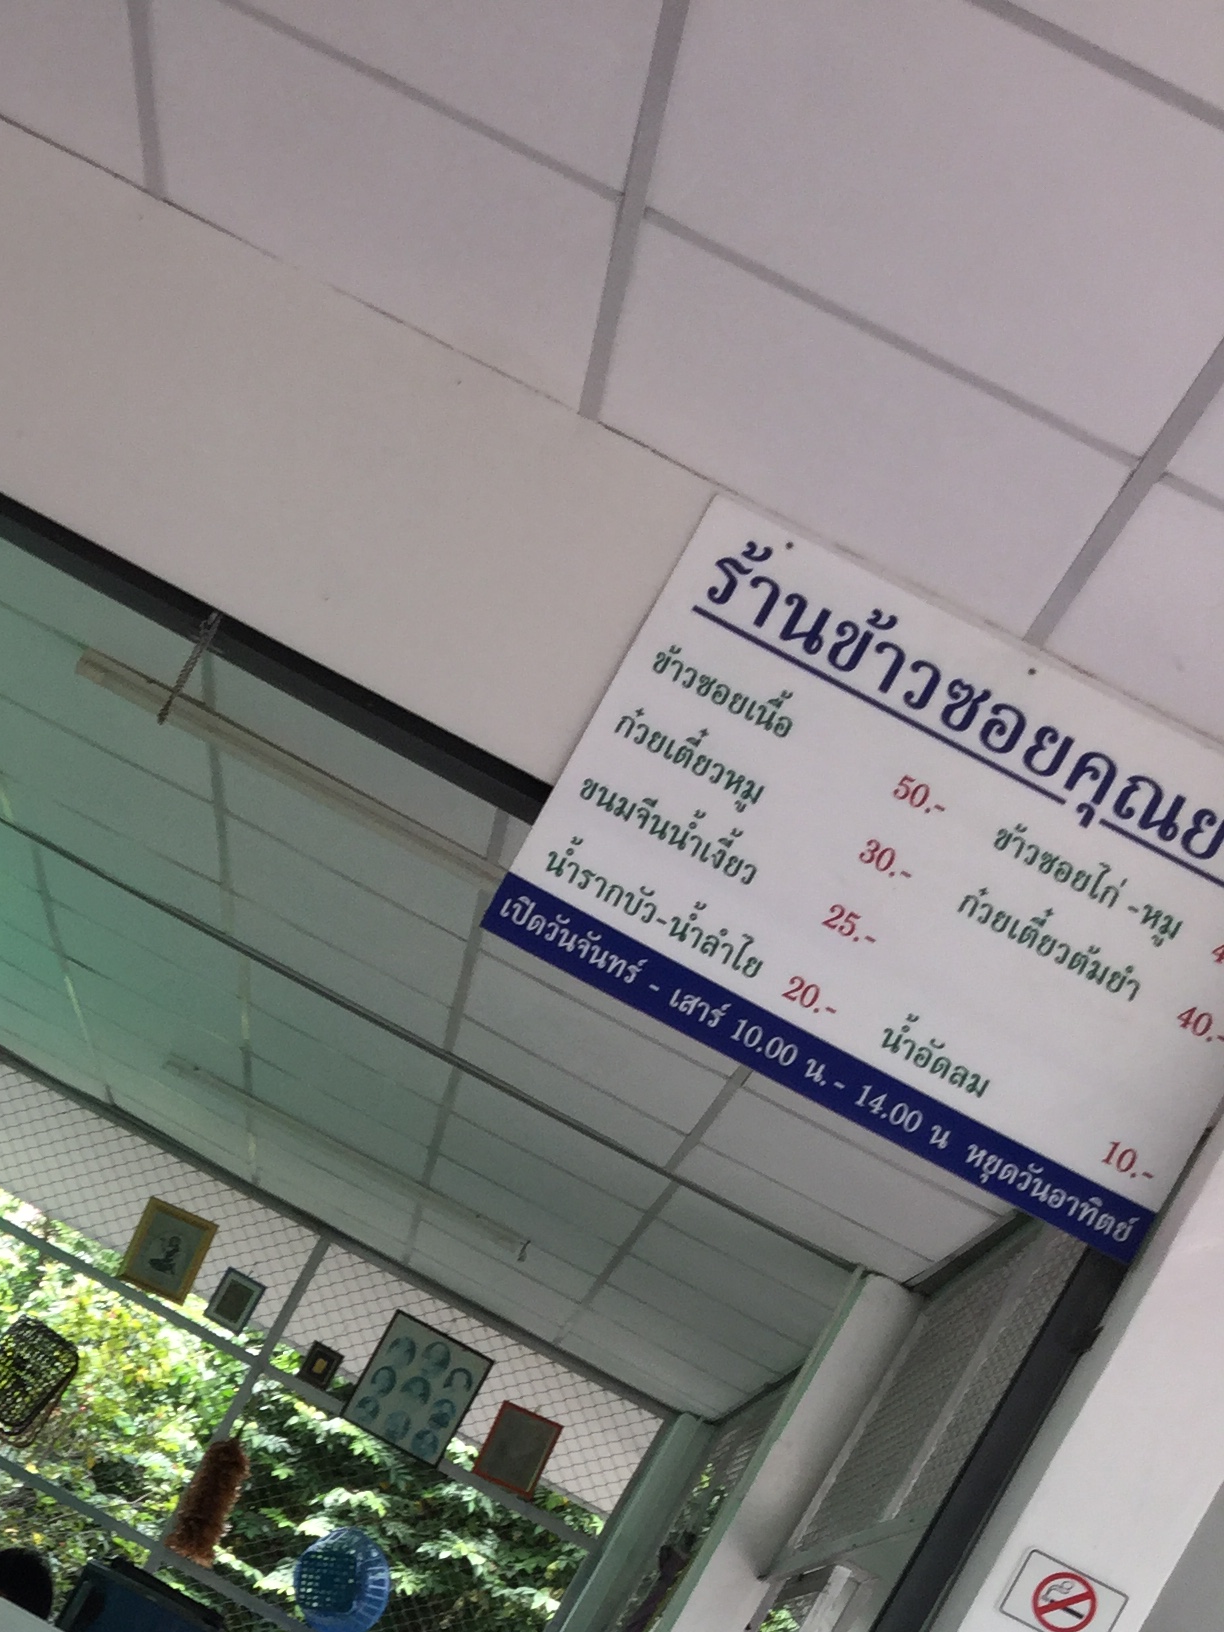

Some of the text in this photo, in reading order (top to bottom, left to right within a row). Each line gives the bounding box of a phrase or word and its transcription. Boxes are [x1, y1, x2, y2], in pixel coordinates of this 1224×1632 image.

[652, 645, 794, 739] ข้าวซอยเนื้อ
[893, 775, 946, 815] 50.-
[579, 777, 877, 945] ขนมจีนน้ำเงี้ยว 25.-
[614, 708, 765, 813] ก๋วยเตี๋ยวหมู
[859, 838, 913, 880] 30.-
[956, 887, 1142, 1002] ก๋วยเตี๋ยวต้มยำ
[500, 895, 650, 985] เปิดวันจันทร์
[669, 987, 732, 1029] เสาร์
[730, 1018, 798, 1066] 10.00
[855, 1085, 923, 1133] 14.00
[965, 1142, 1139, 1243] หยุดวันอาทิตย์
[782, 975, 838, 1016] 20.-
[881, 1012, 991, 1099] น้ำอัดลม
[1101, 1140, 1155, 1181] 10.-
